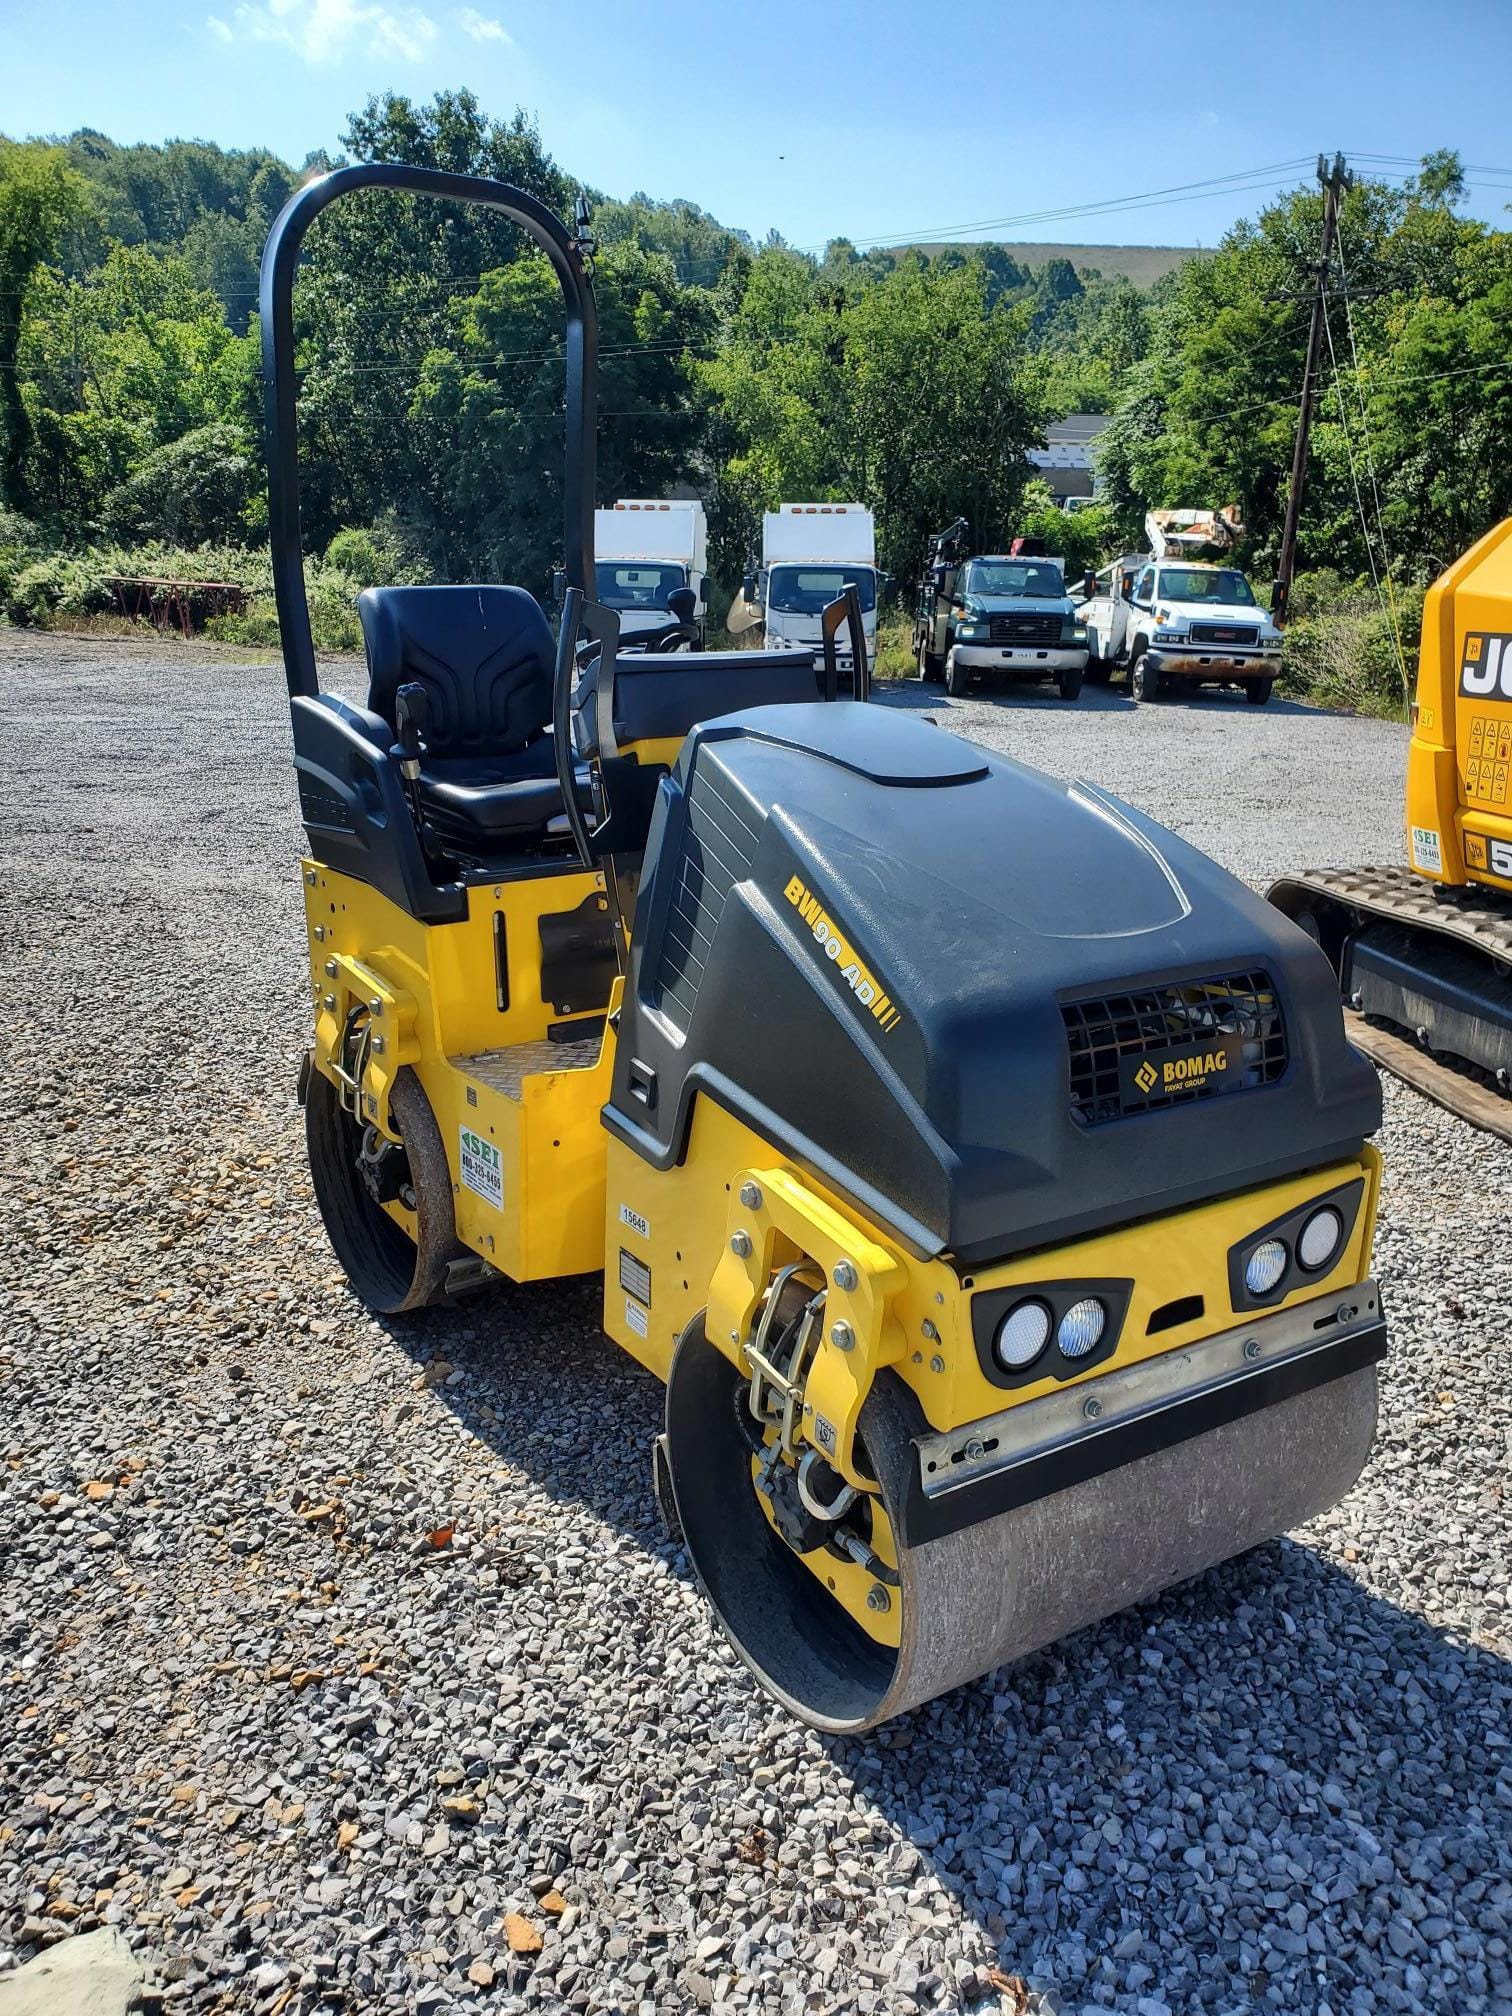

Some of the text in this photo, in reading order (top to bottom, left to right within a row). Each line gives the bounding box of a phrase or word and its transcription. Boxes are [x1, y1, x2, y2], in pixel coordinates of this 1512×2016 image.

[1417, 830, 1438, 846] SEI
[1163, 1050, 1227, 1083] BOMAG
[1164, 1077, 1206, 1093] FAYAT GROUP
[470, 1133, 500, 1169] SEI
[623, 1208, 647, 1233] 15648
